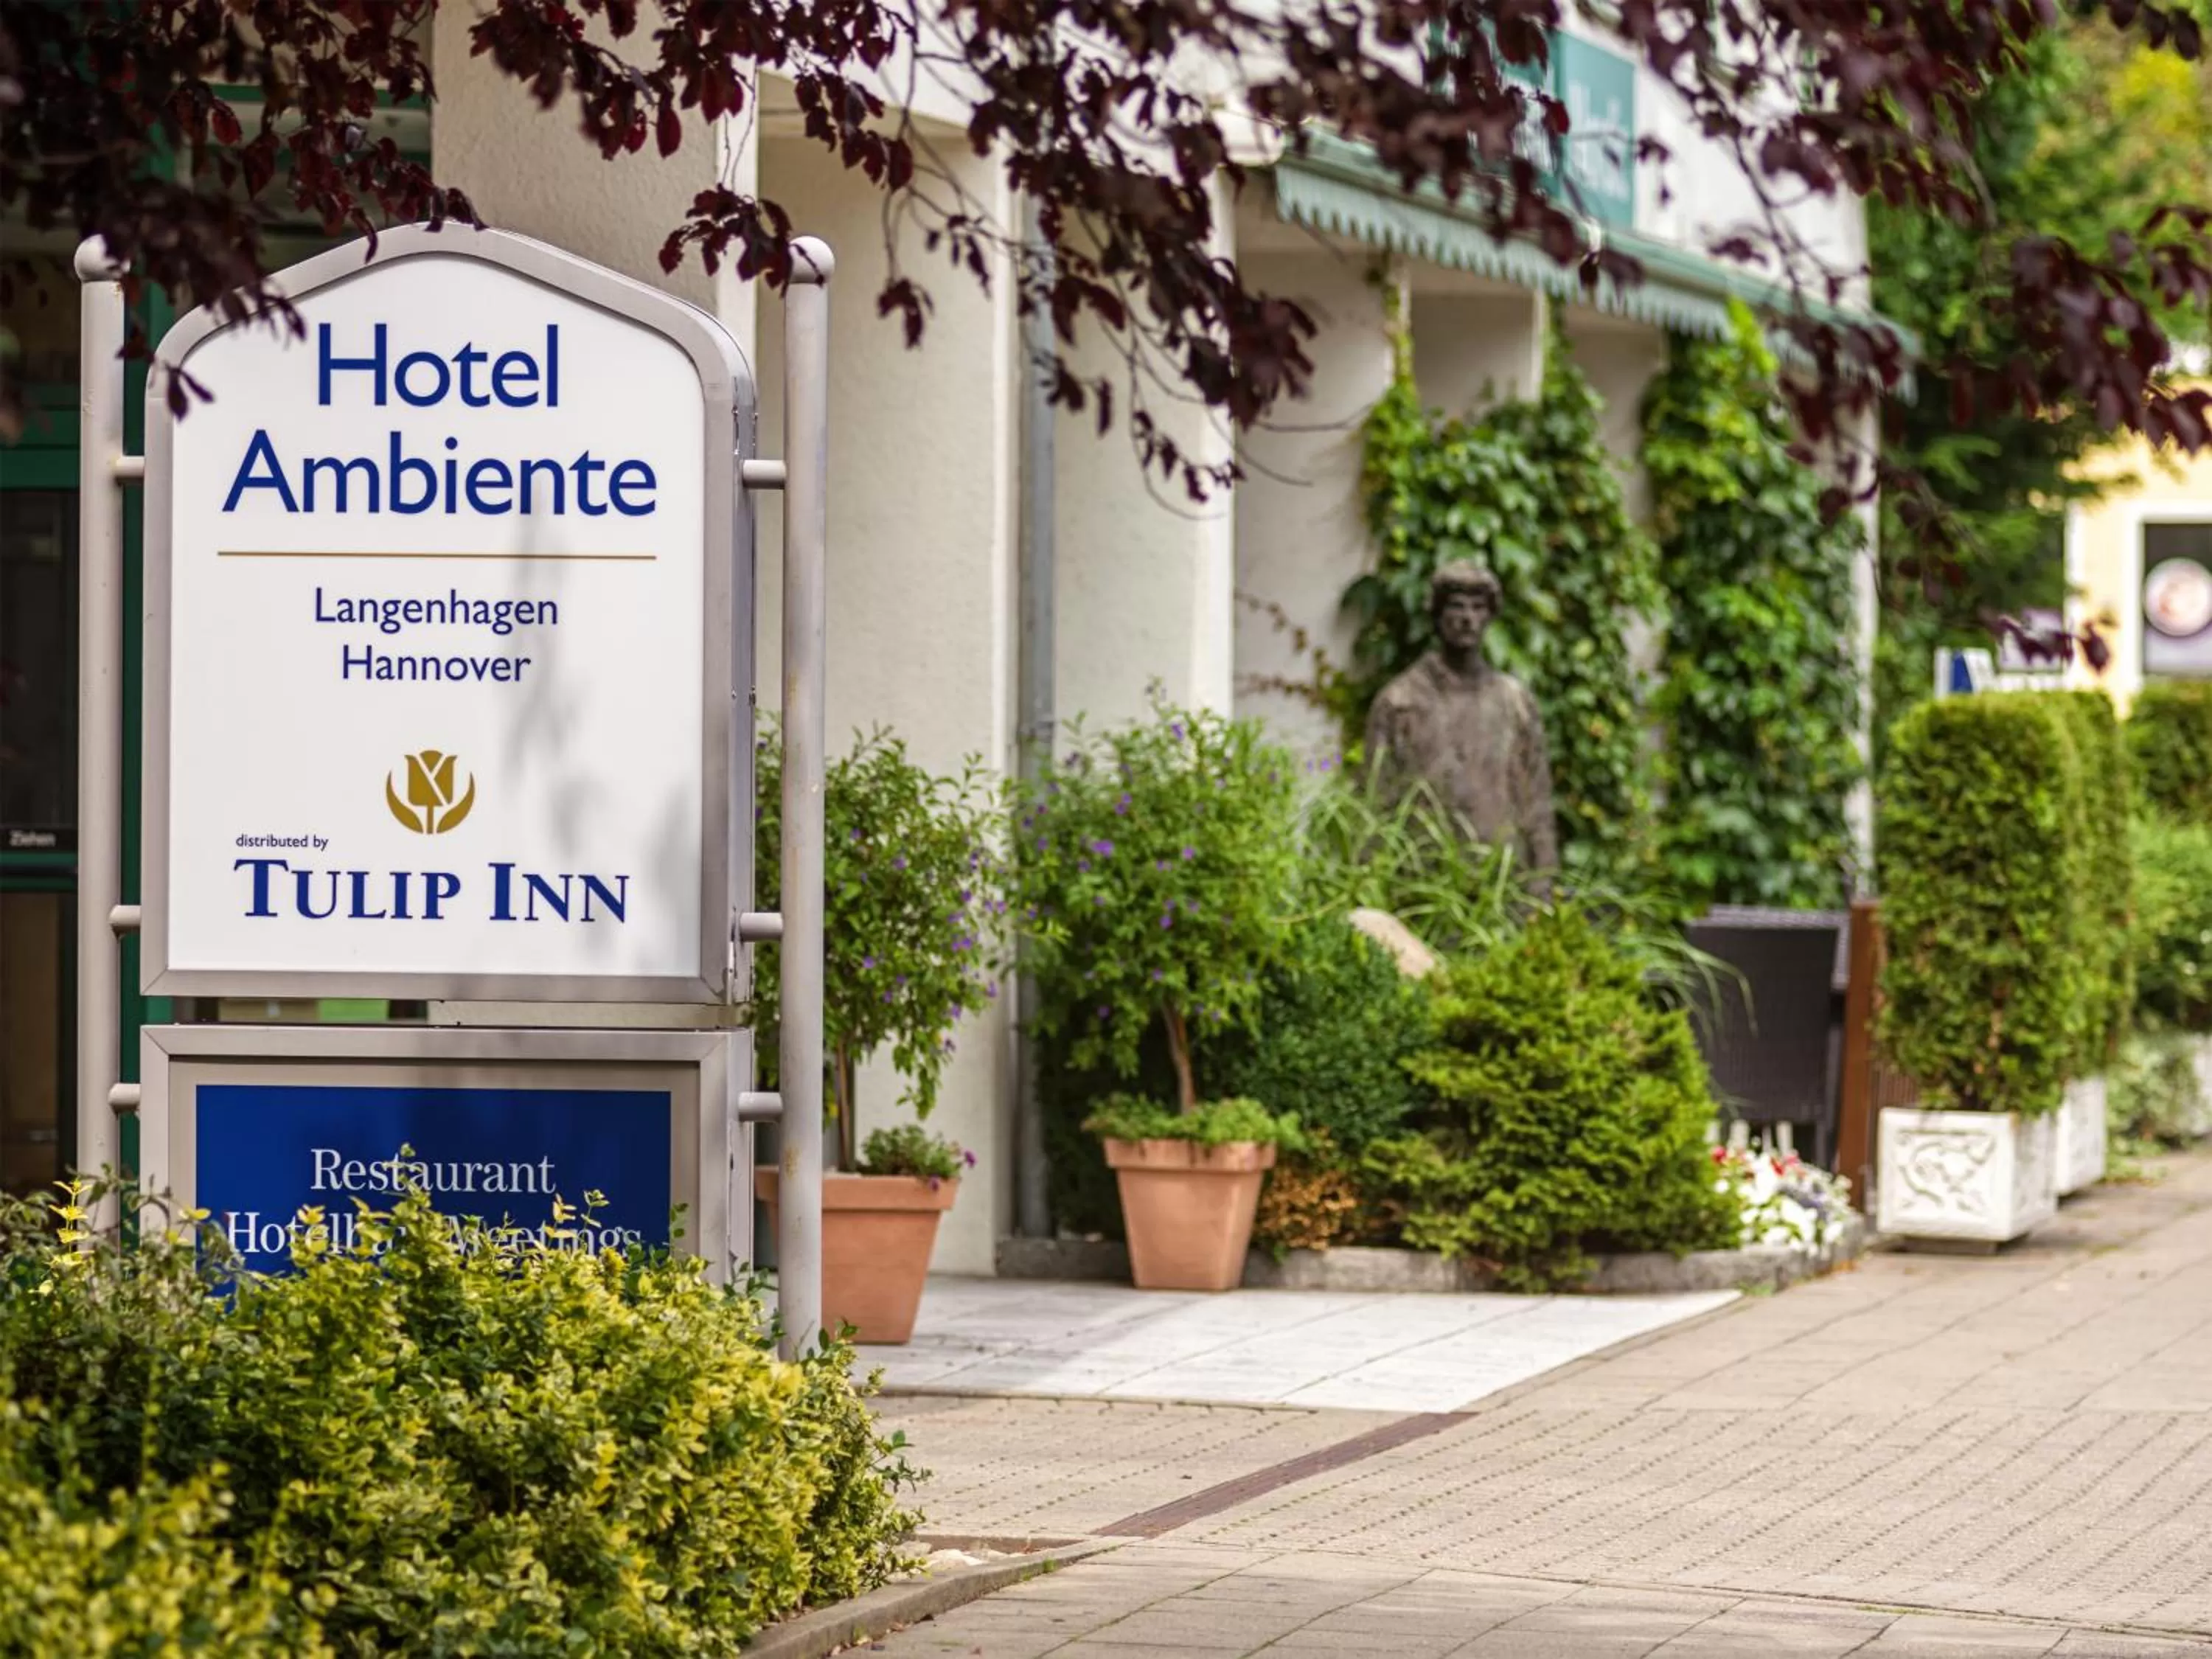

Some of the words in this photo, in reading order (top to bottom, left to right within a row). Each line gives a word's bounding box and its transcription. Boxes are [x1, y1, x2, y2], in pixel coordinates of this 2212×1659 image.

[319, 323, 558, 408] Hotel
[223, 429, 657, 516] Ambiente
[316, 588, 558, 635] Langenhagen
[342, 644, 531, 681] Hannover
[236, 834, 308, 847] distributed
[313, 835, 329, 852] by
[234, 860, 461, 920] TULIP
[487, 862, 630, 923] INN
[310, 1148, 557, 1194] Restaurant
[225, 1211, 410, 1254] Hotelba
